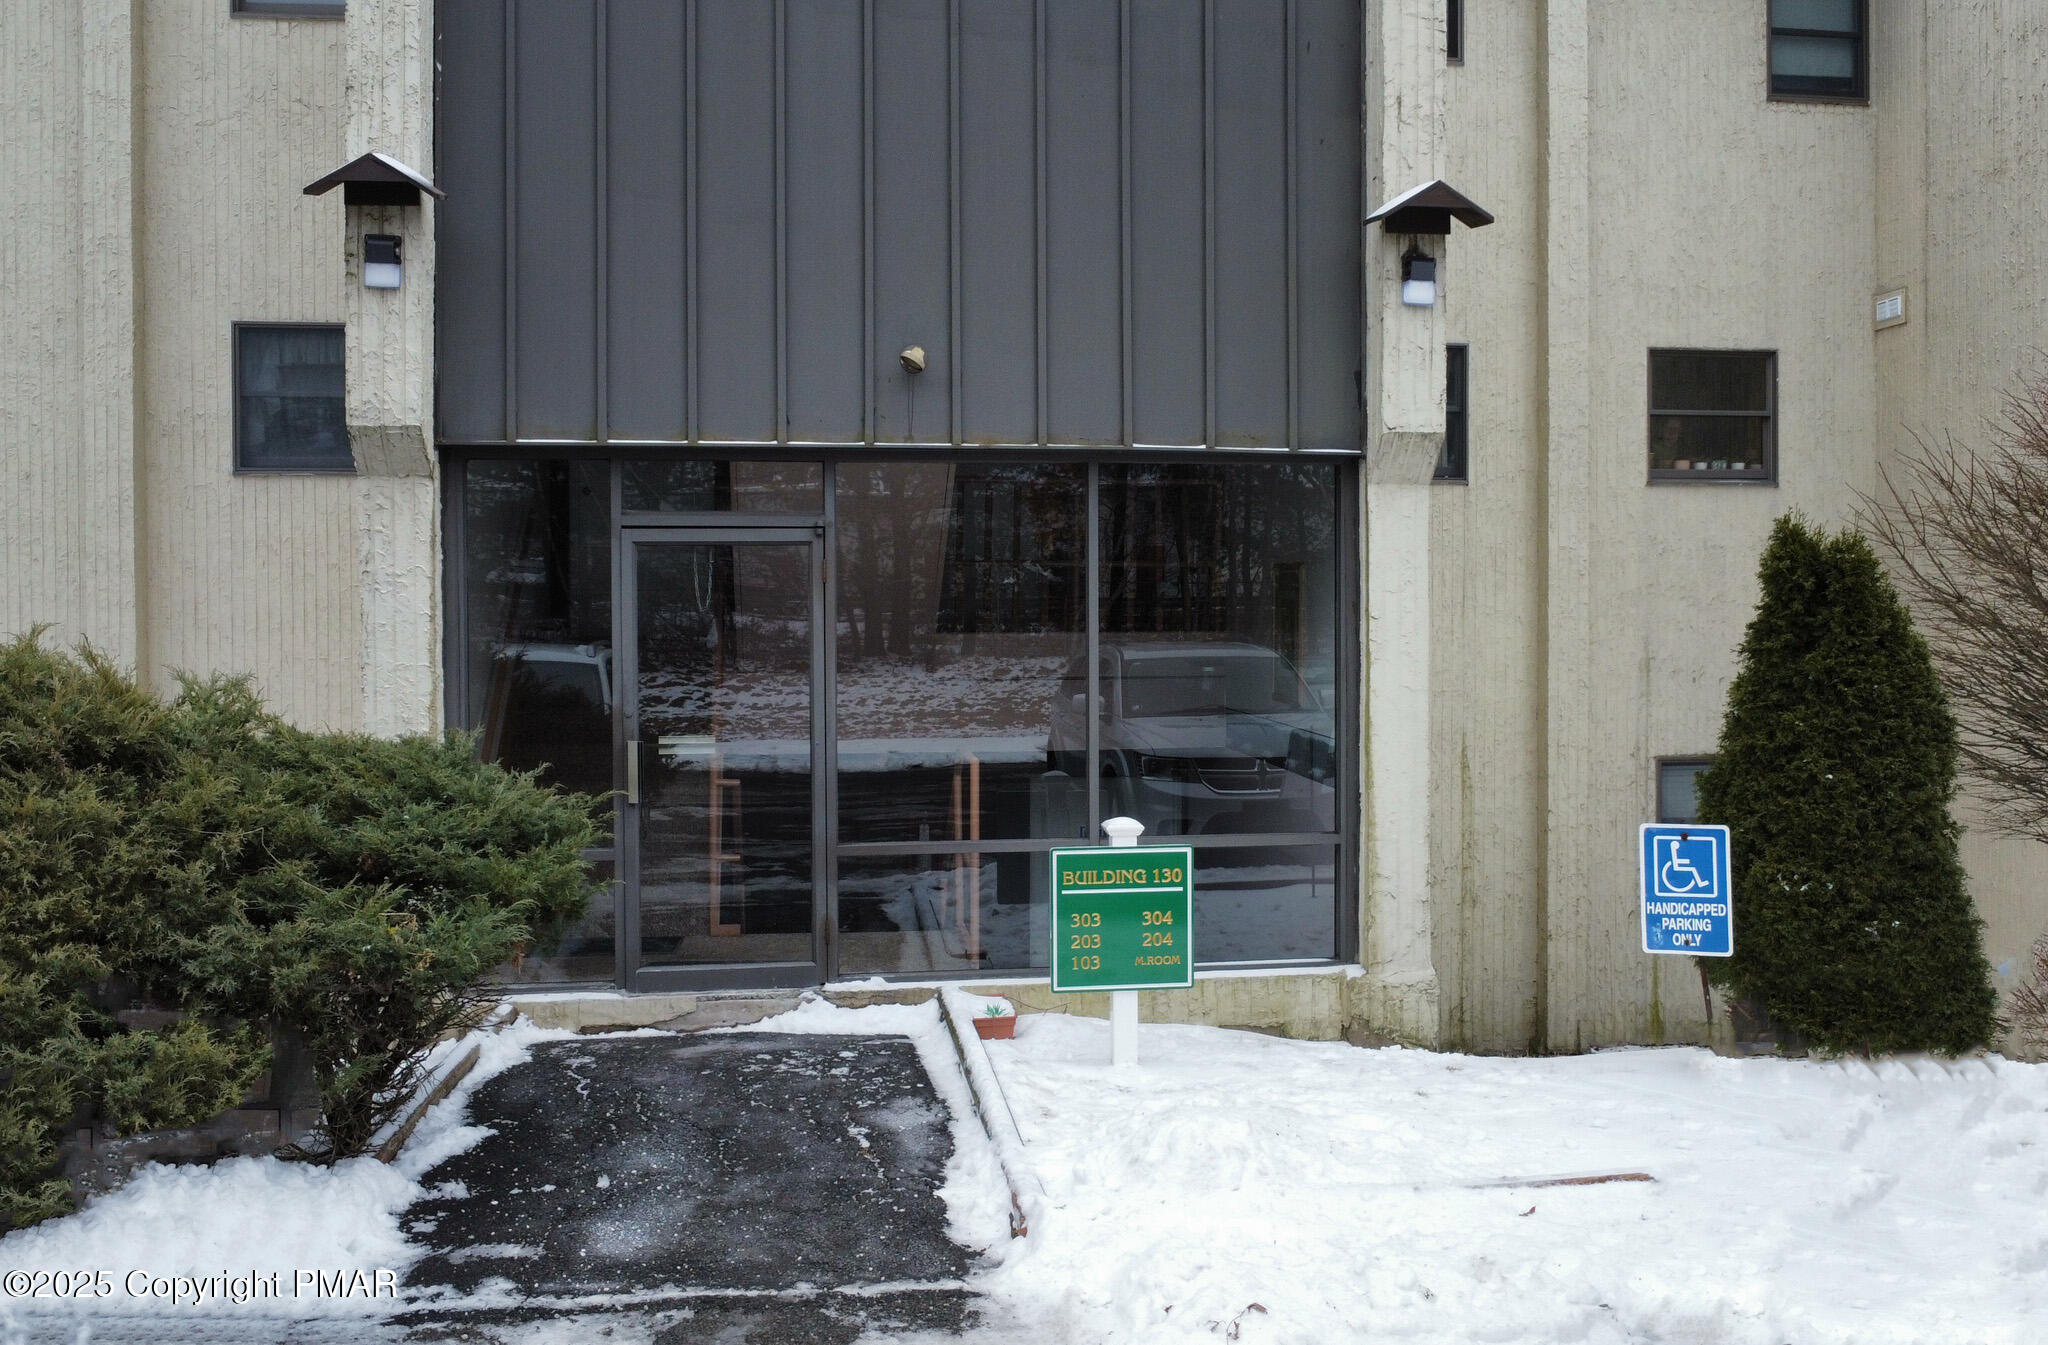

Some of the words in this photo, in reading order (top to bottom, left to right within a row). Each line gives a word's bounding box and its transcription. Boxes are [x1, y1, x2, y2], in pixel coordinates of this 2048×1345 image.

[1062, 869, 1147, 886] BUILDING
[1152, 867, 1183, 883] 130
[1646, 902, 1726, 917] HANDICAPPED
[1070, 912, 1101, 928] 303
[1141, 910, 1173, 926] 304
[1661, 917, 1712, 932] PARKING
[1070, 934, 1101, 949] 203
[1141, 932, 1173, 947] 204
[1672, 932, 1702, 947] ONLY
[1071, 955, 1101, 971] 103
